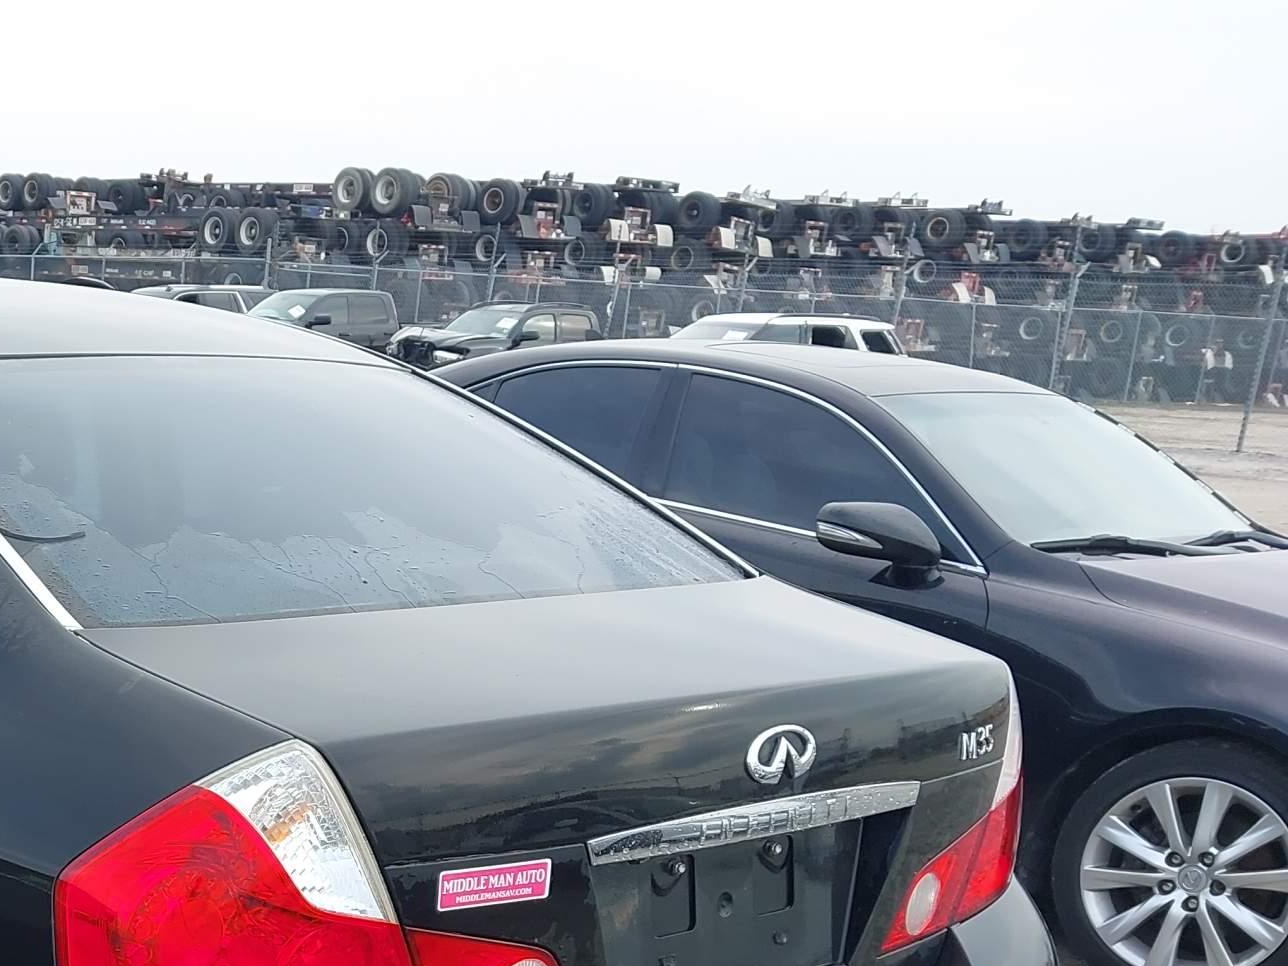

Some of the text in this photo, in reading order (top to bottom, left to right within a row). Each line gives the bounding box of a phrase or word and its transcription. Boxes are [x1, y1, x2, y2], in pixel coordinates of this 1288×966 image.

[961, 724, 993, 760] M35
[442, 869, 546, 894] MIDDLE MAN AUTO
